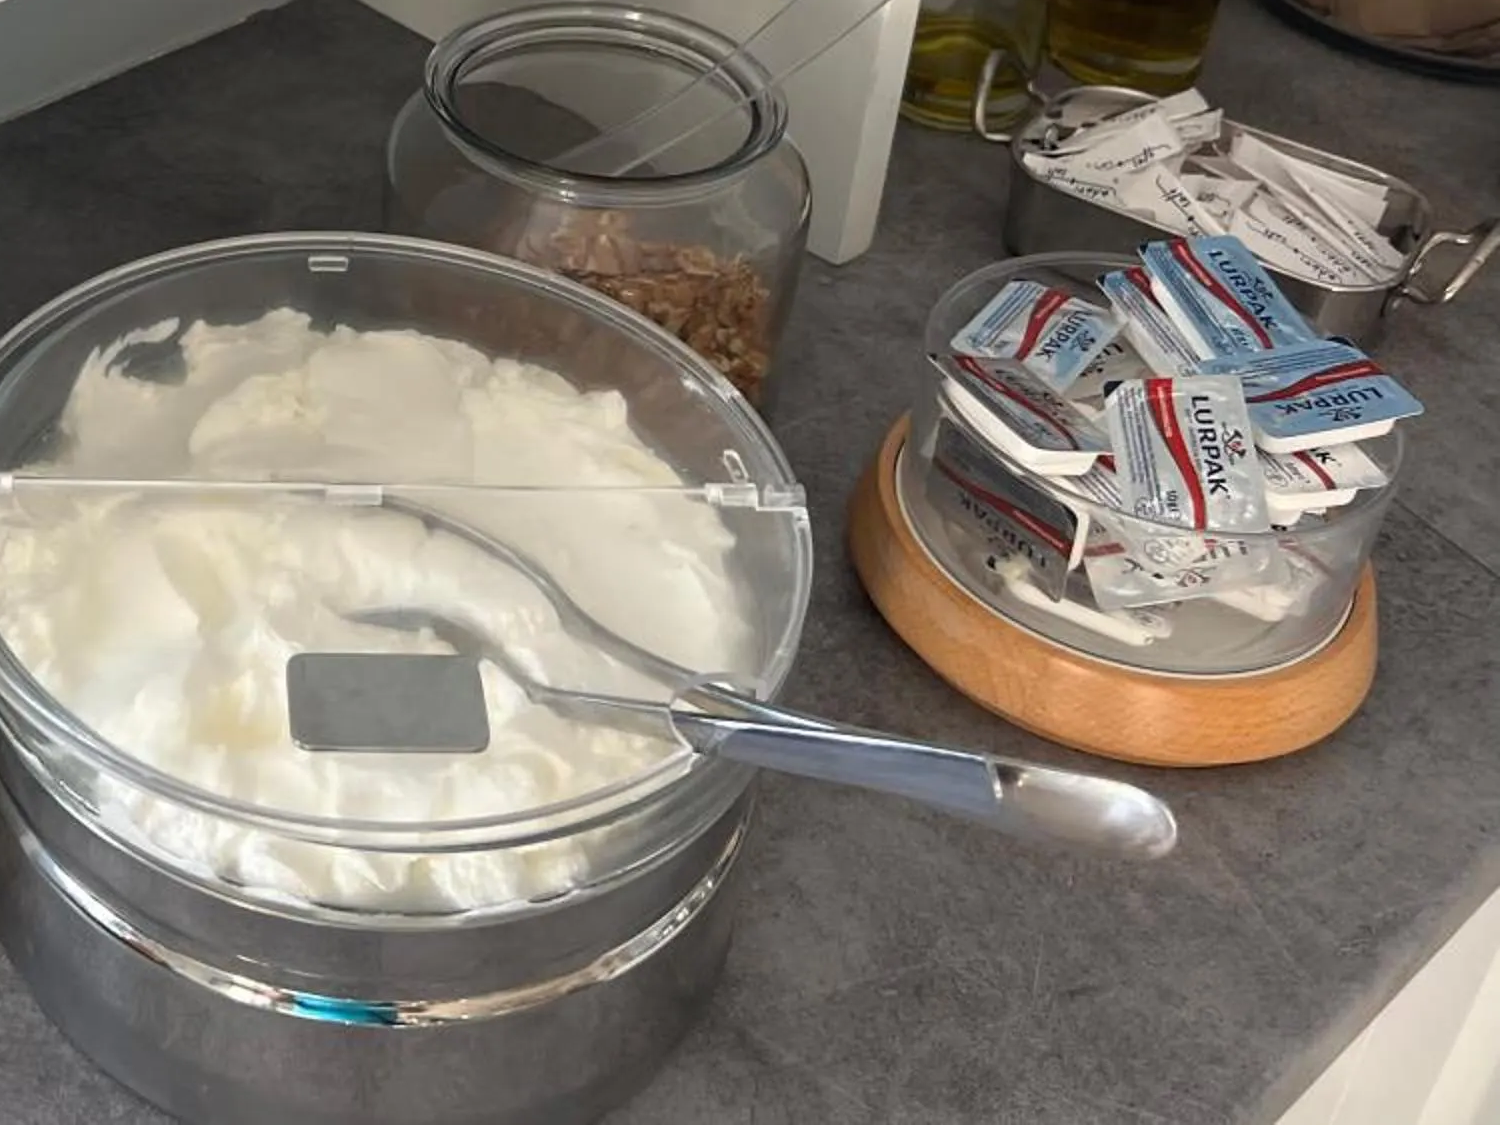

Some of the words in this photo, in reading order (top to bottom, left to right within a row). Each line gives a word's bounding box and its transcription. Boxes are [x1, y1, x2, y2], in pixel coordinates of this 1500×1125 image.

[1208, 250, 1277, 329] LURPAK
[1035, 309, 1093, 363] LURPAK
[1274, 386, 1384, 415] LURPAK
[1191, 394, 1230, 496] LURPAK
